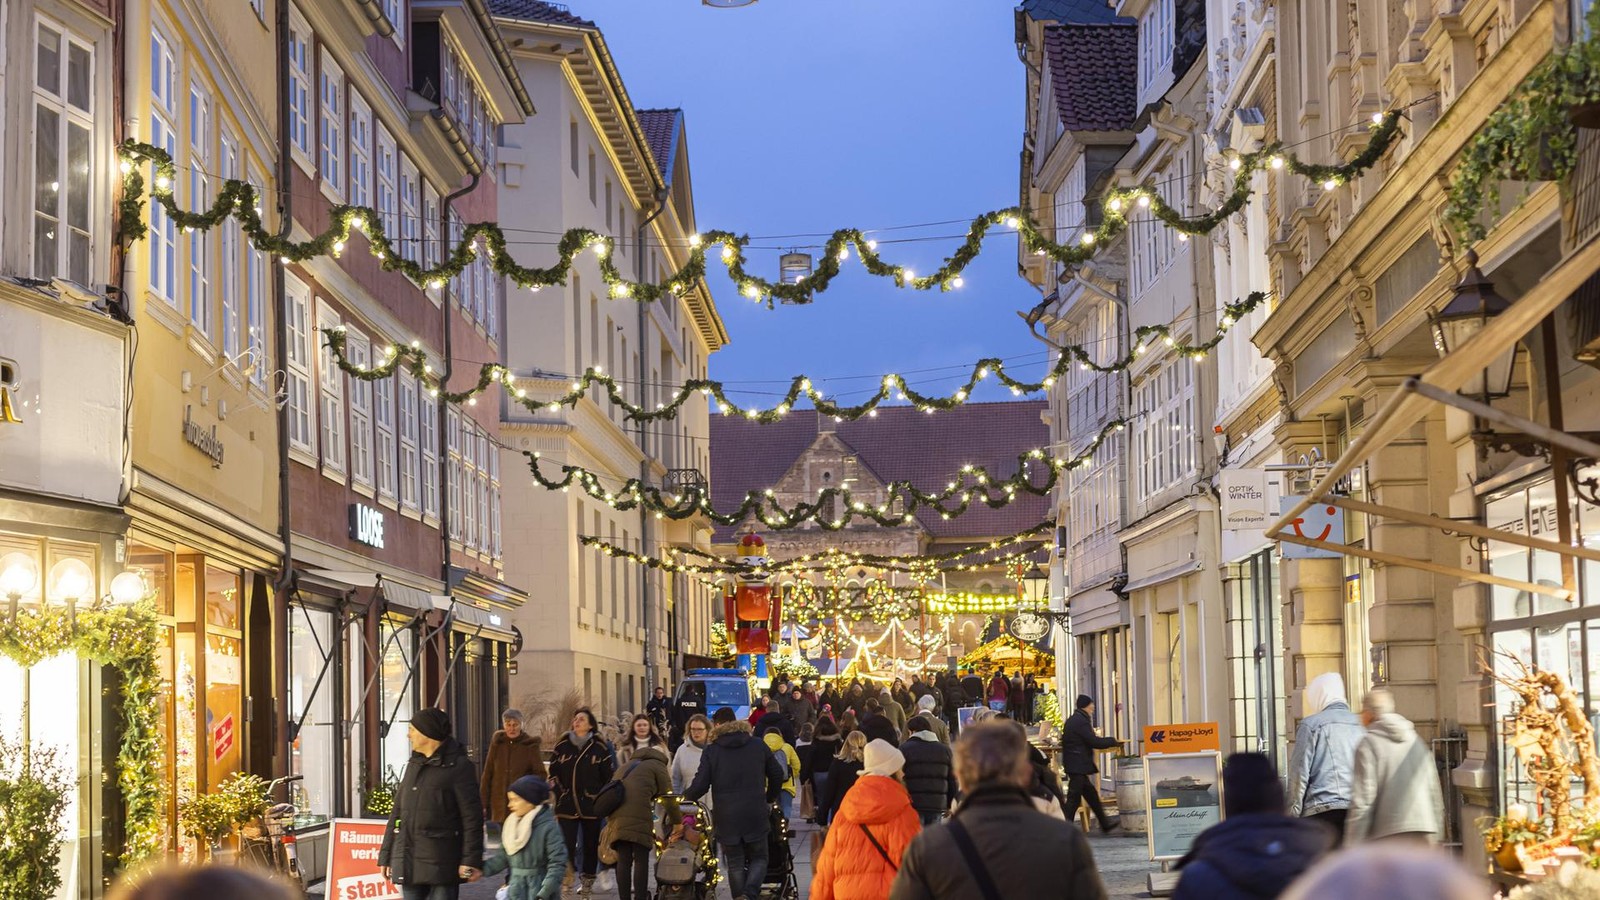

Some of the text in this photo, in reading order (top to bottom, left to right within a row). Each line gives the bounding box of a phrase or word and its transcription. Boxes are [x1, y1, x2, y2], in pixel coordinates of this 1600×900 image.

[1228, 485, 1254, 493] OPTIK
[1228, 492, 1262, 500] WINTER
[356, 502, 384, 549] LOOSE
[1169, 728, 1213, 737] Hapag-Lloyd
[346, 880, 399, 900] stark
